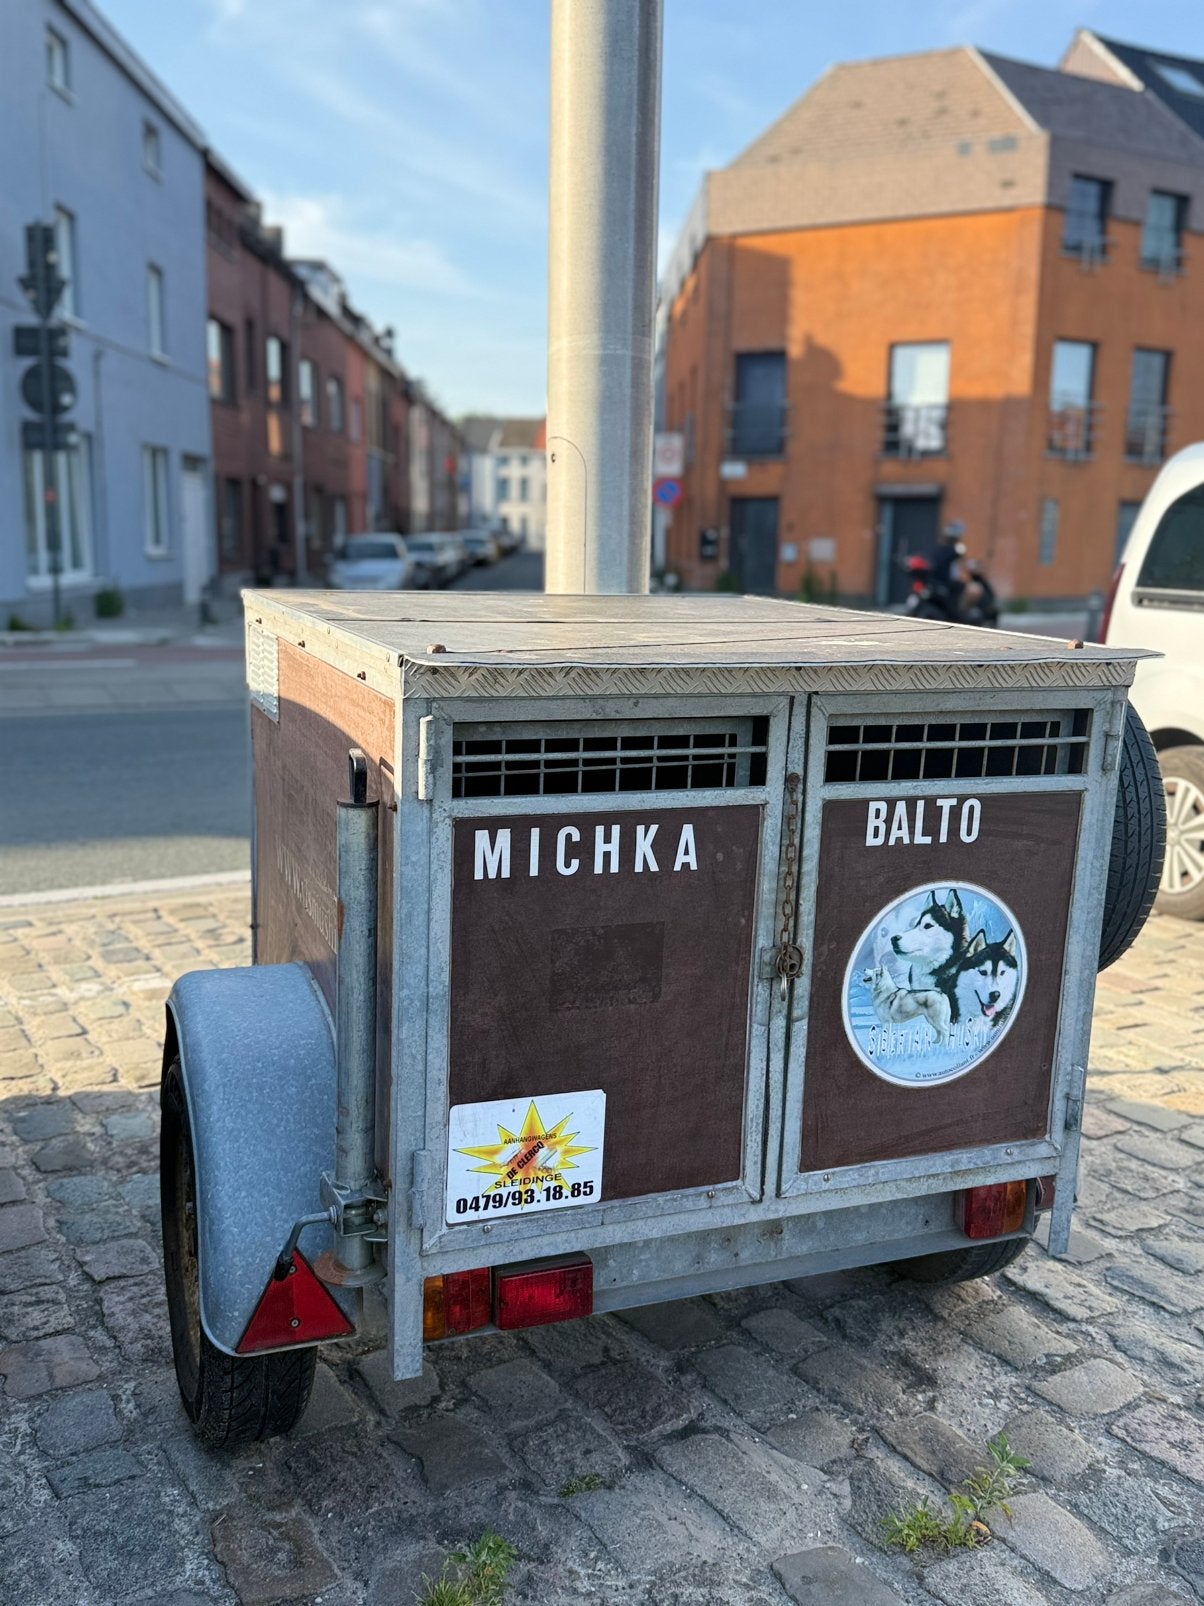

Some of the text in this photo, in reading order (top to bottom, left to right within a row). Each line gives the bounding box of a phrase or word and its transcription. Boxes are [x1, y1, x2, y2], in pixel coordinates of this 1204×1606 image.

[865, 797, 982, 847] BALTO
[473, 823, 699, 881] MICHKA
[503, 1132, 557, 1145] AANHANGWAGENS
[494, 1172, 562, 1189] SLEIDINGE
[506, 1166, 519, 1180] DE
[455, 1180, 595, 1214] 0479/93.18.85
